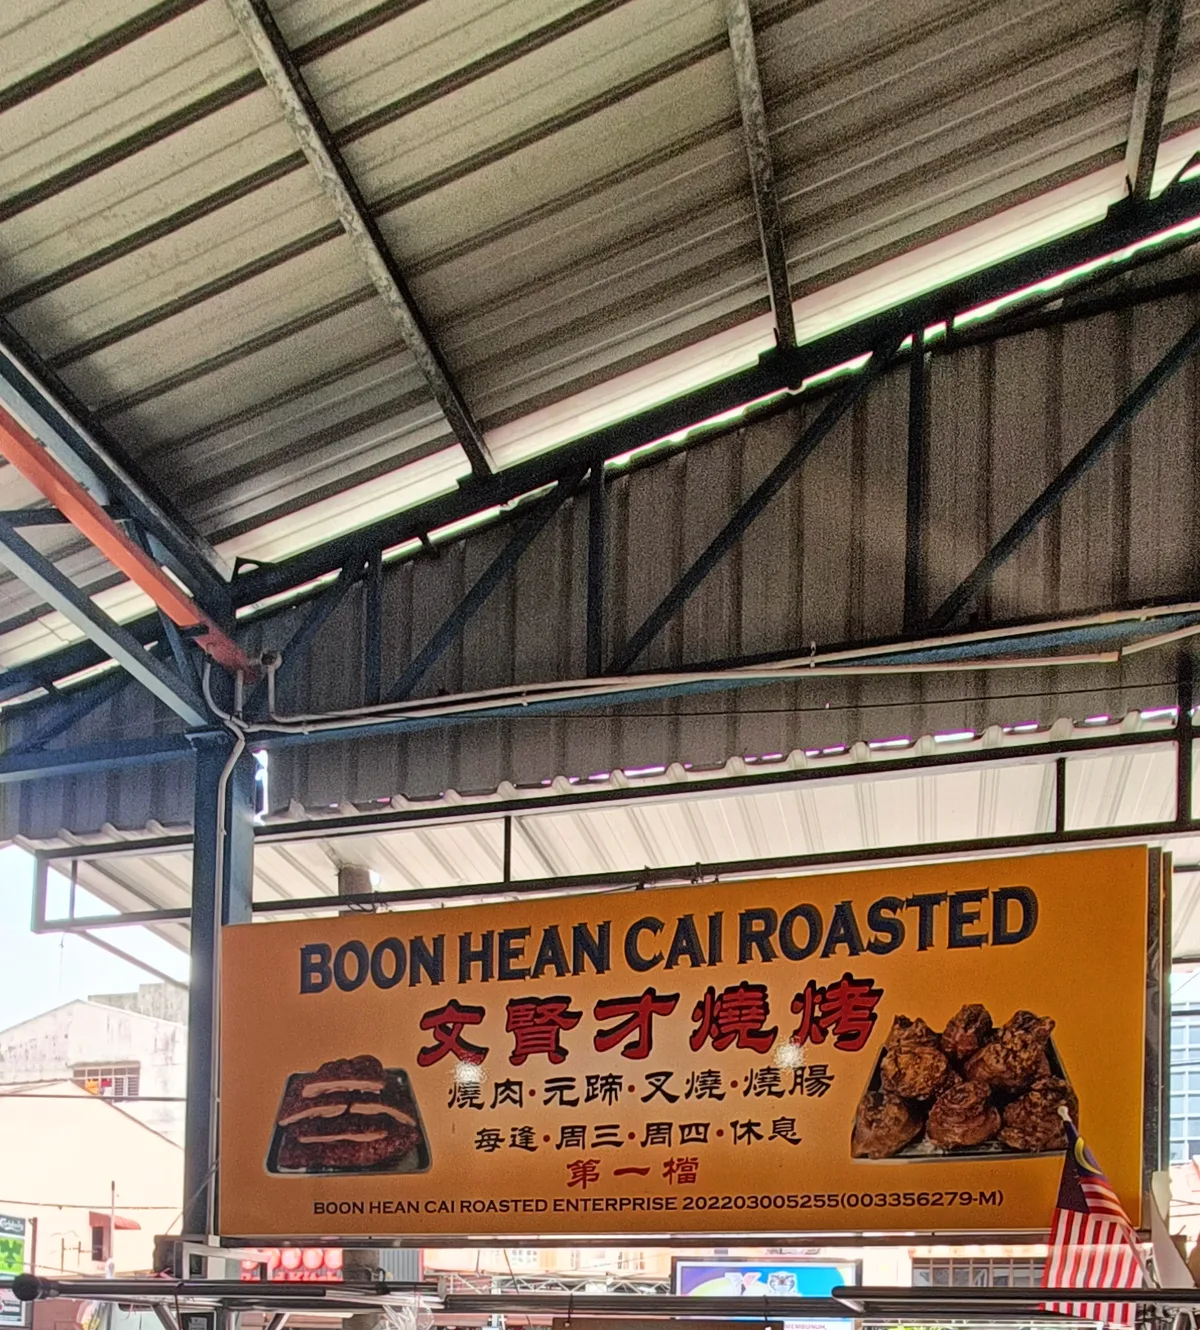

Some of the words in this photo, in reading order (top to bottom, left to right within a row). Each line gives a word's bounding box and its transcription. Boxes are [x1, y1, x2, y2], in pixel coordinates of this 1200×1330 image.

[299, 934, 446, 994] BOON
[458, 921, 612, 982] HEAN
[624, 910, 723, 972] CAI
[737, 886, 1039, 965] ROASTED
[416, 972, 884, 1067] 文賢才燒烤
[313, 1200, 364, 1214] BOON
[369, 1199, 421, 1214] HEAN
[424, 1199, 456, 1213] CAI
[460, 1197, 547, 1213] ROASTED
[553, 1196, 678, 1212] ENTERPRISE
[682, 1190, 1004, 1210] 202203005255(003356279-M)
[566, 1156, 699, 1190] 第一檔
